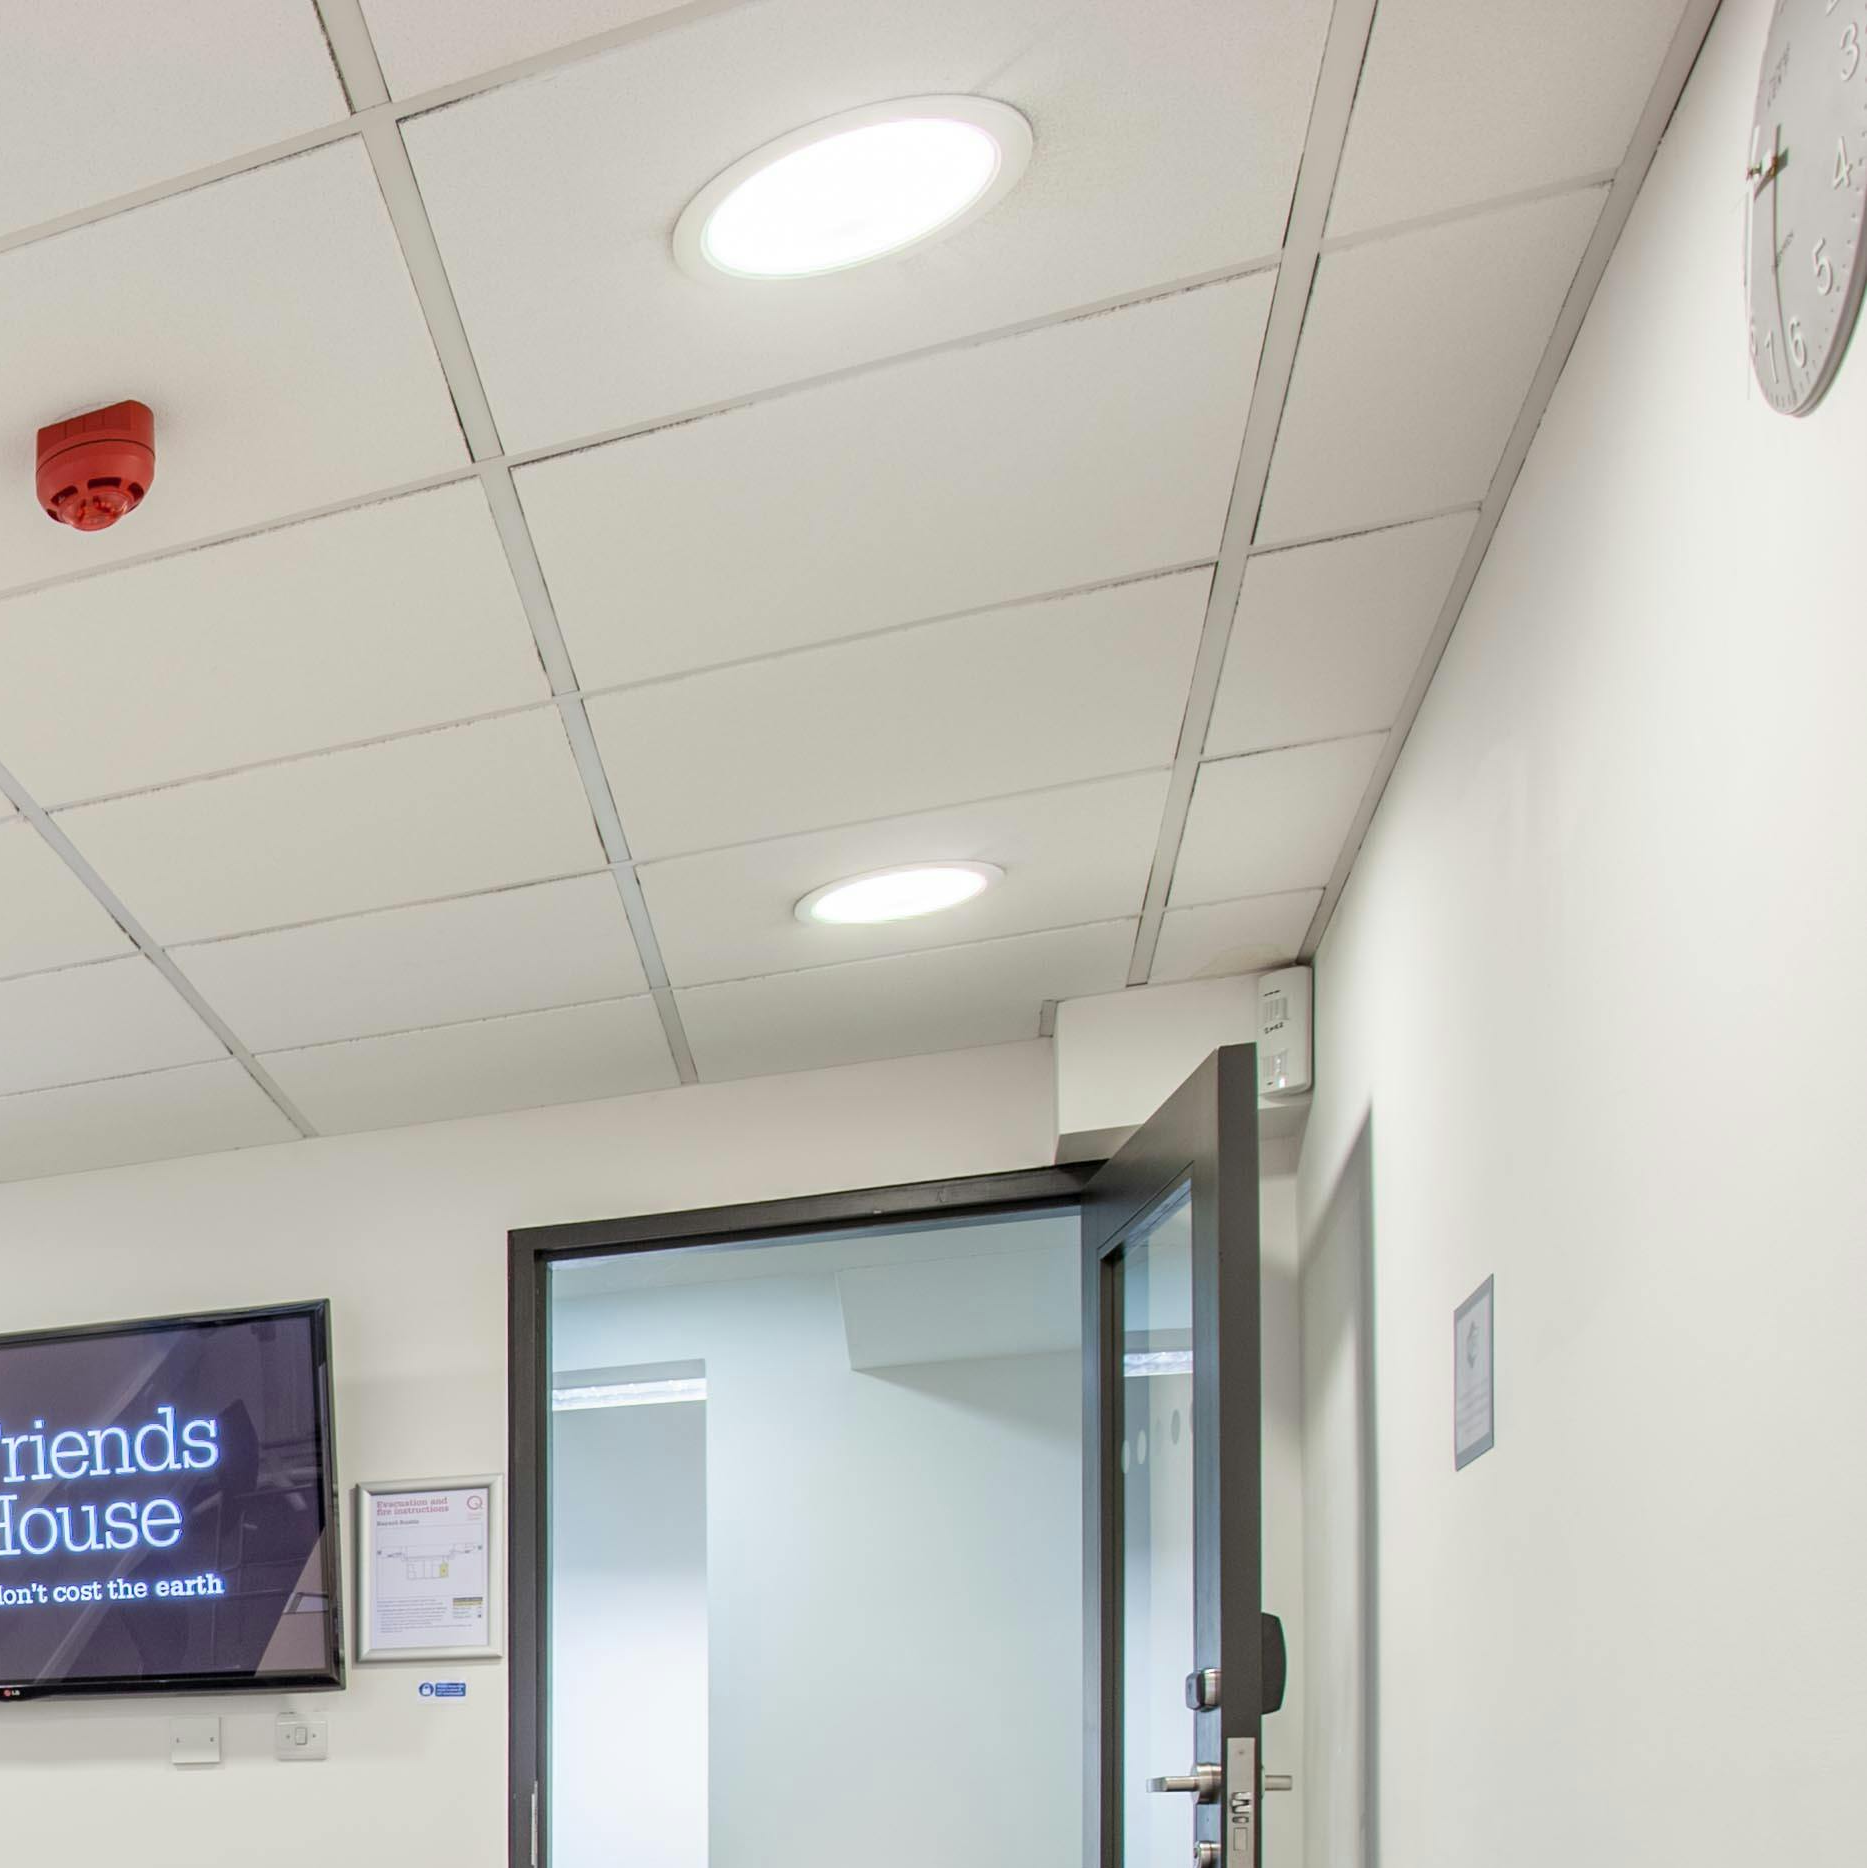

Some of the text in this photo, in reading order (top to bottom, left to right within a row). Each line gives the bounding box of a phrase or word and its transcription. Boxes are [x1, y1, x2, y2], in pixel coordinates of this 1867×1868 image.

[1840, 20, 1860, 82] 3
[1832, 134, 1853, 190] 4
[1813, 236, 1834, 297] 5
[1789, 315, 1807, 369] 6
[376, 1497, 448, 1508] Evacuation and
[376, 1505, 449, 1516] fire instructions
[52, 1580, 104, 1604] cost
[106, 1577, 149, 1601] the
[155, 1573, 225, 1598] earth
